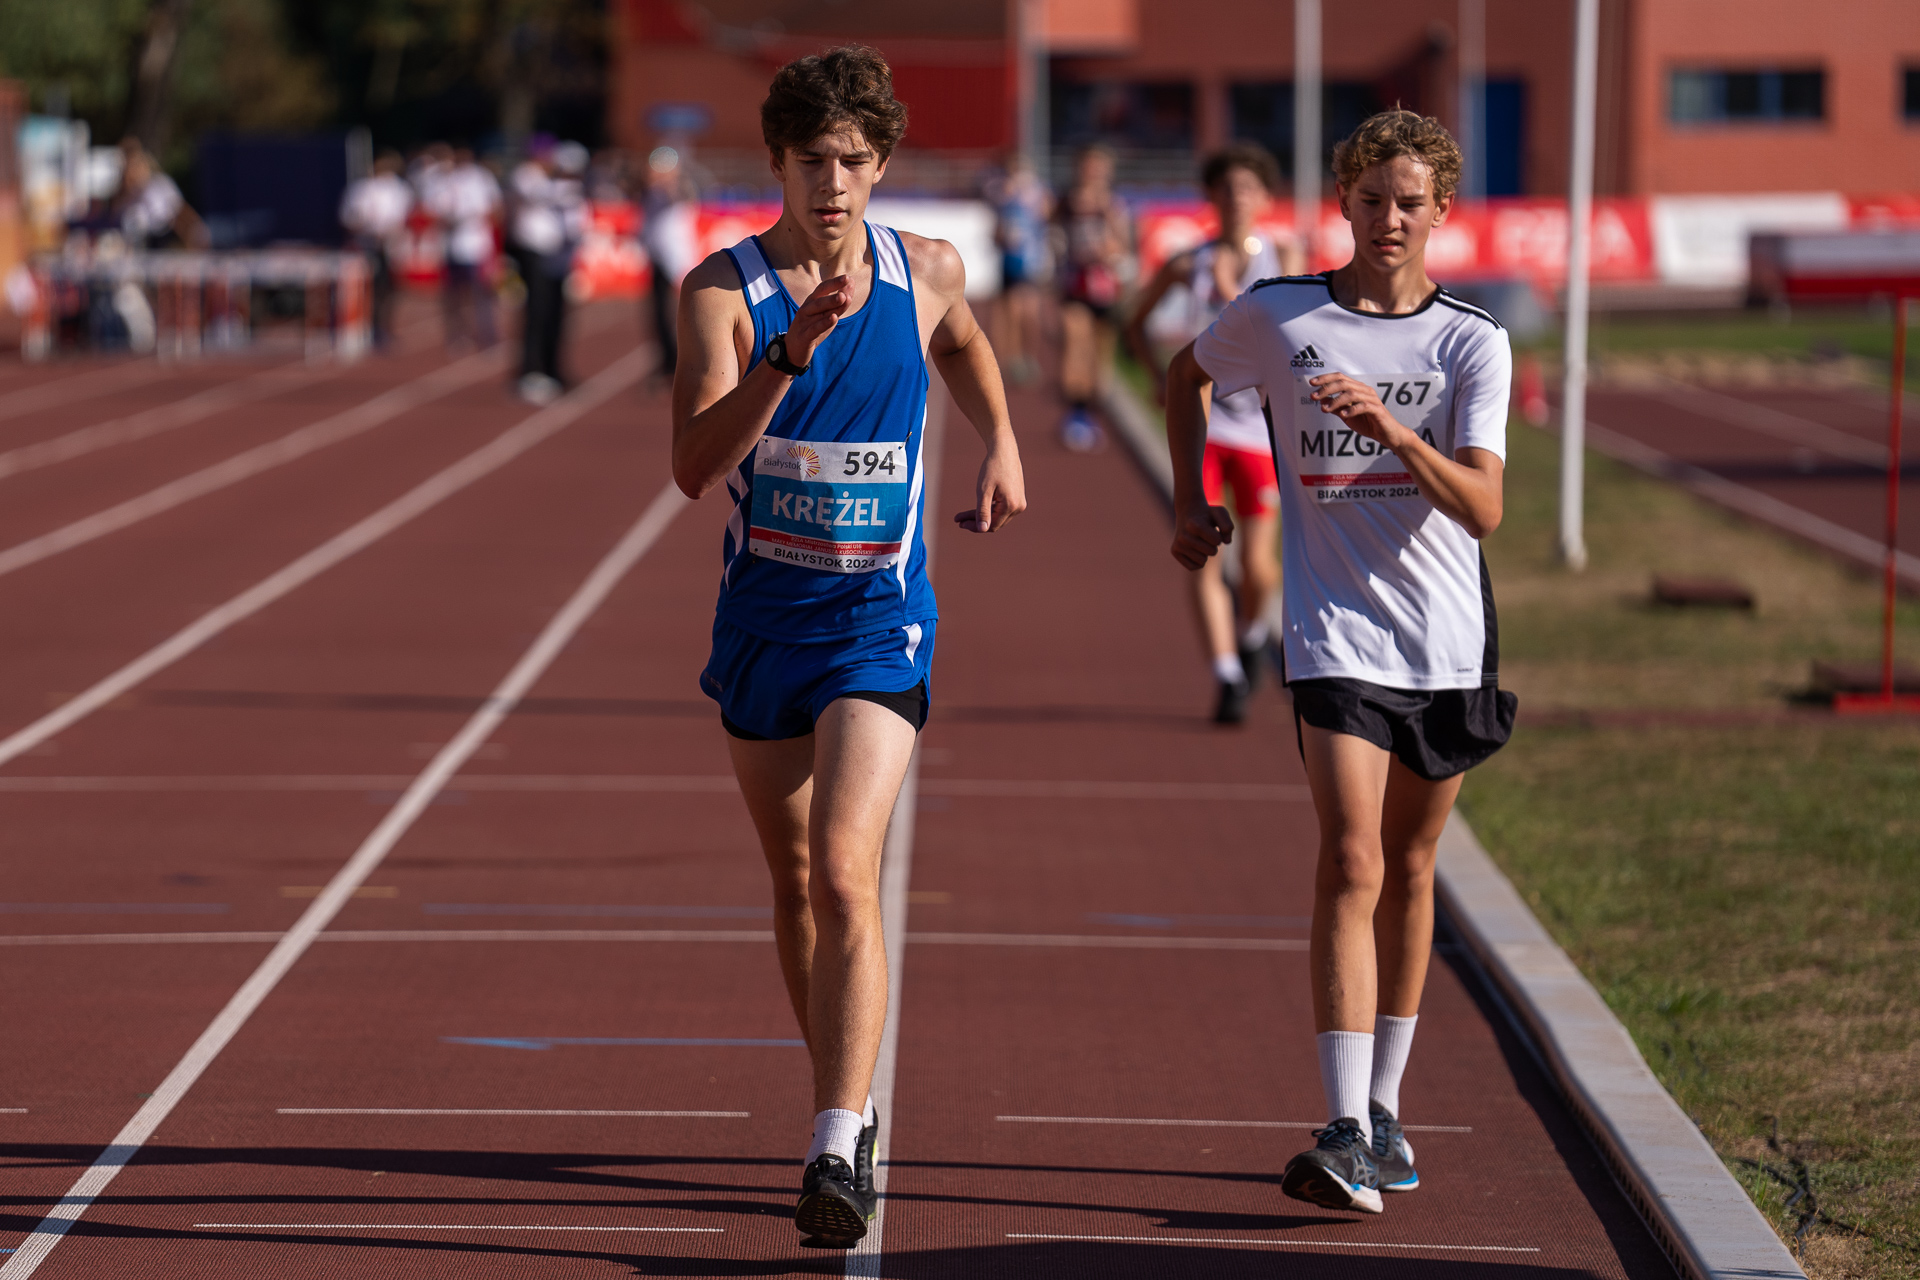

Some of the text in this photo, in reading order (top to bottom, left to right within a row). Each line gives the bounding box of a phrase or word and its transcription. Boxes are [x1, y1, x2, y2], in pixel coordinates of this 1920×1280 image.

[1290, 359, 1325, 368] adidas
[1377, 381, 1431, 406] 767
[764, 458, 802, 470] Białystok
[843, 450, 896, 475] 594
[1317, 486, 1420, 499] BIAŁYSTOK 2024
[772, 490, 886, 531] KRĘŻEL
[774, 547, 876, 569] BIAŁYSTOK 2024
